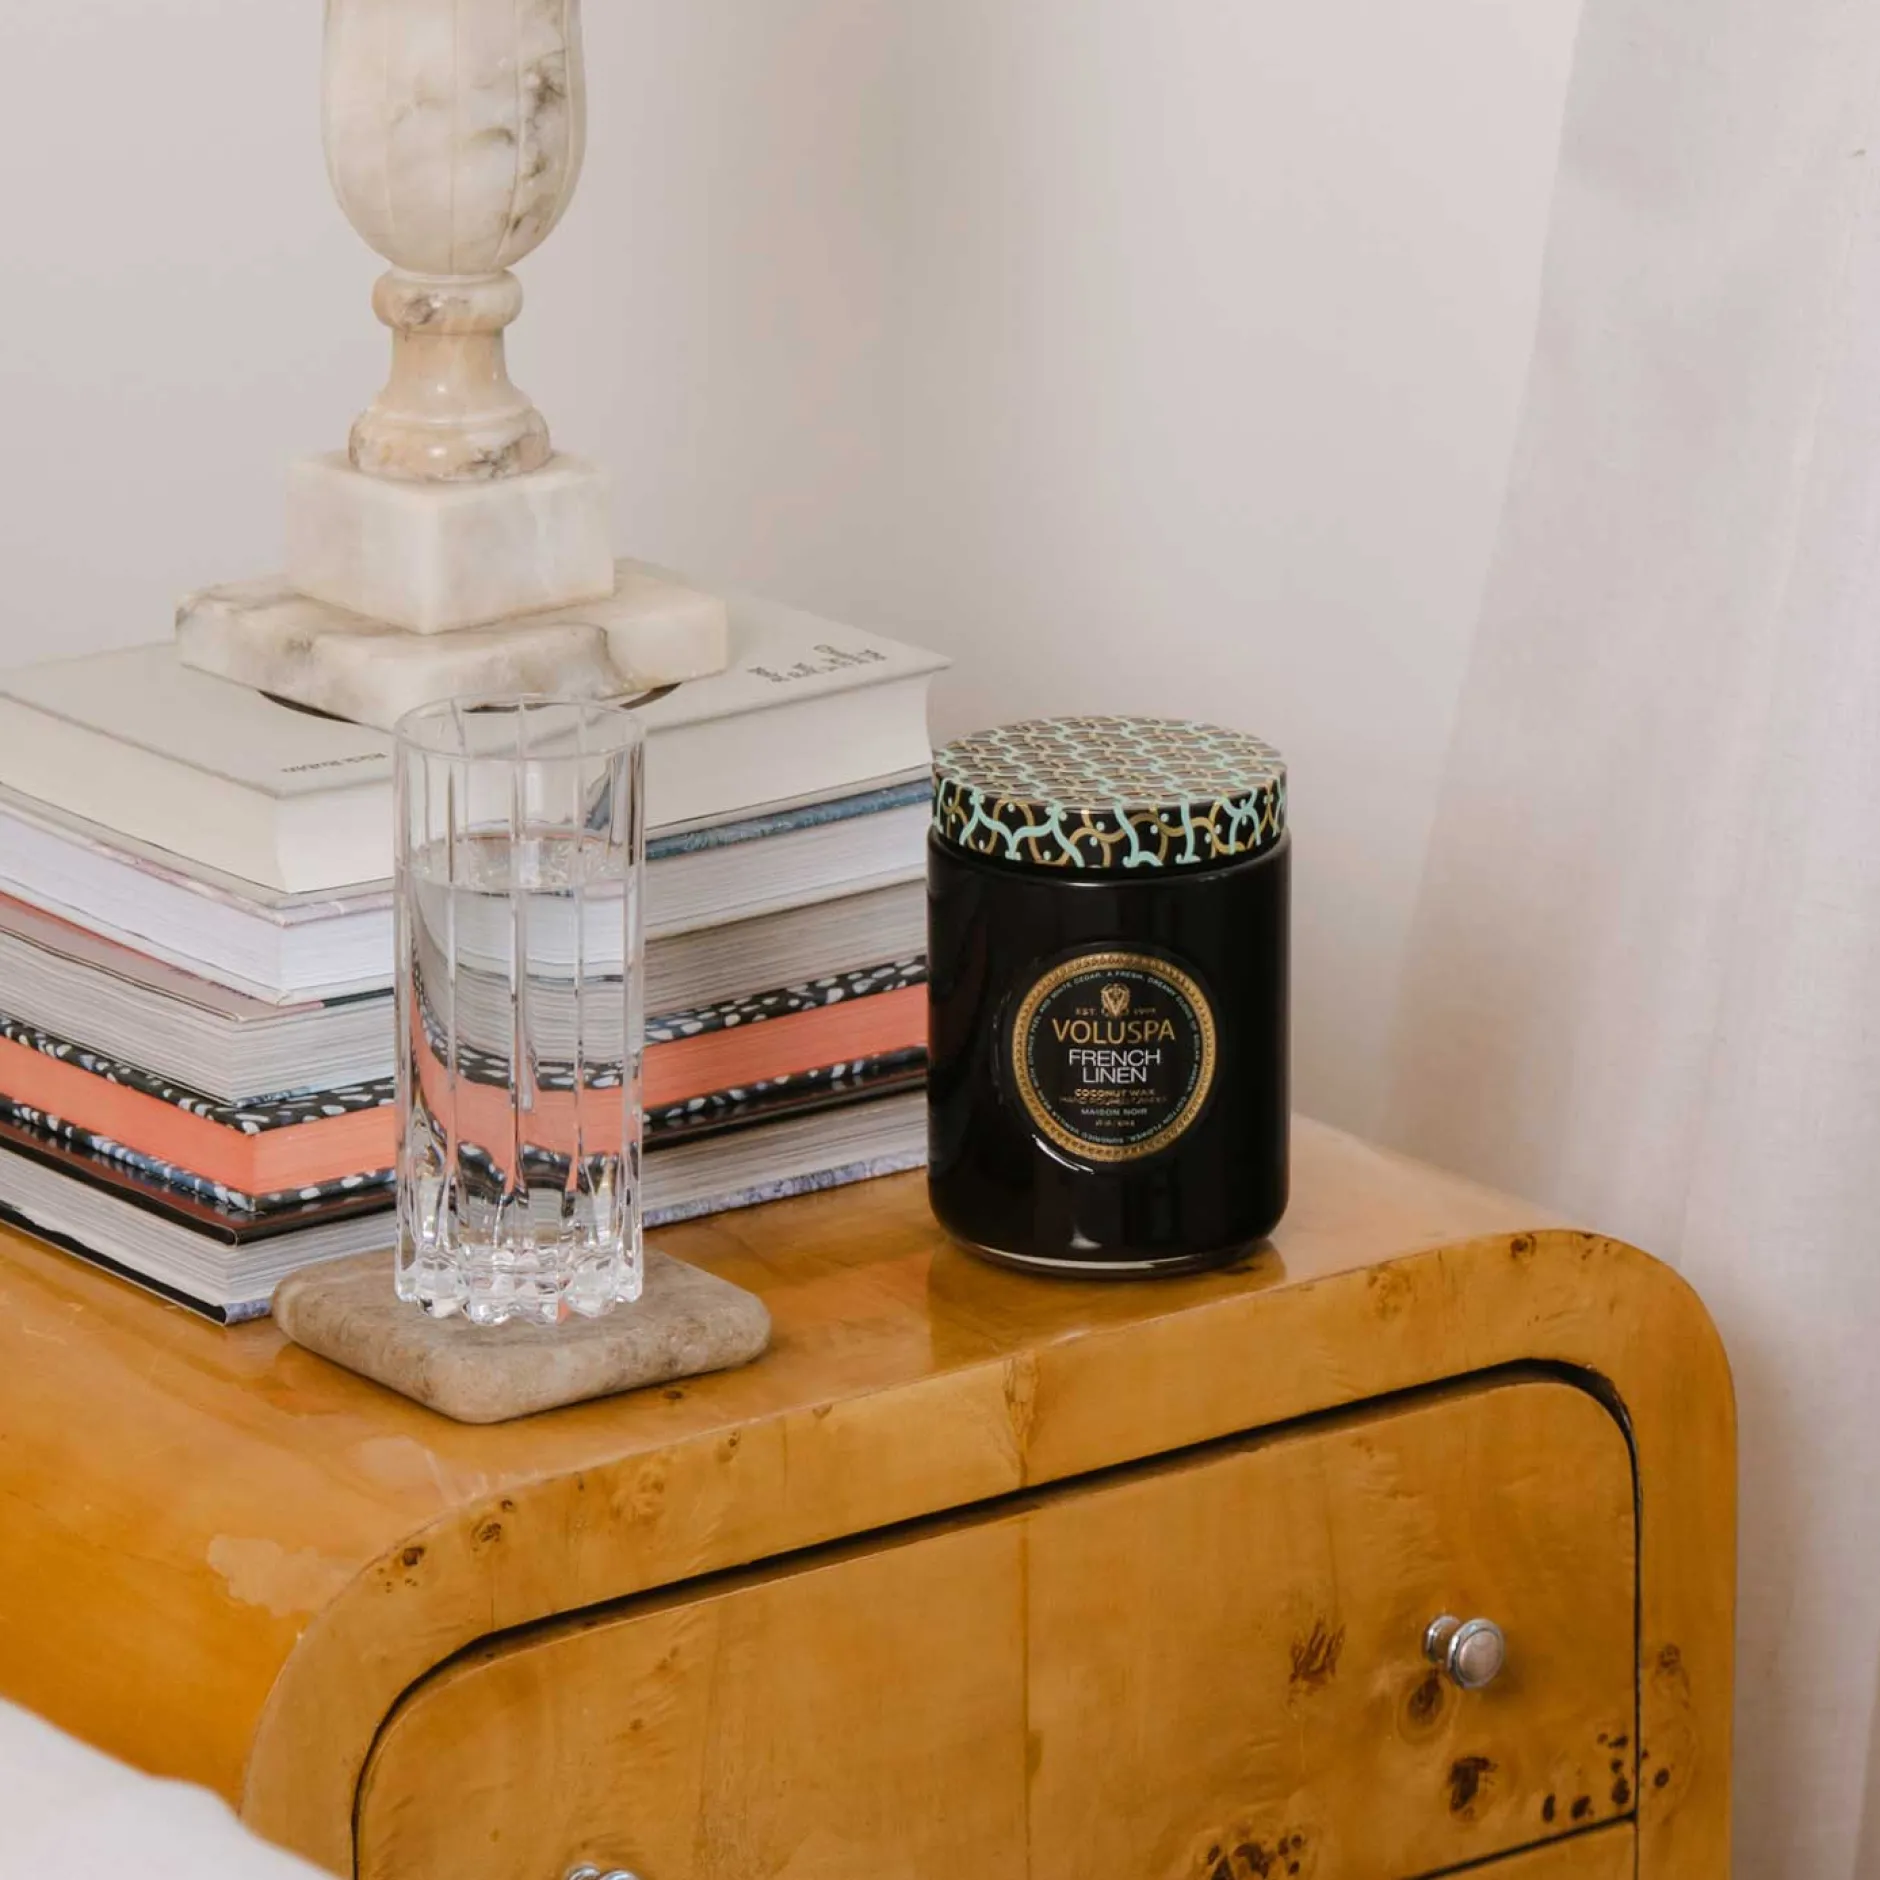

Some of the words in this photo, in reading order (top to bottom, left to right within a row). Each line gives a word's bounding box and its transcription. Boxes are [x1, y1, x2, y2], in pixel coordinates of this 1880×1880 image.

[1052, 1018, 1176, 1044] VOLUSPA
[1069, 1048, 1161, 1067] FRENCH
[1082, 1066, 1147, 1084] LINEN
[1074, 1088, 1126, 1098] COCONUT
